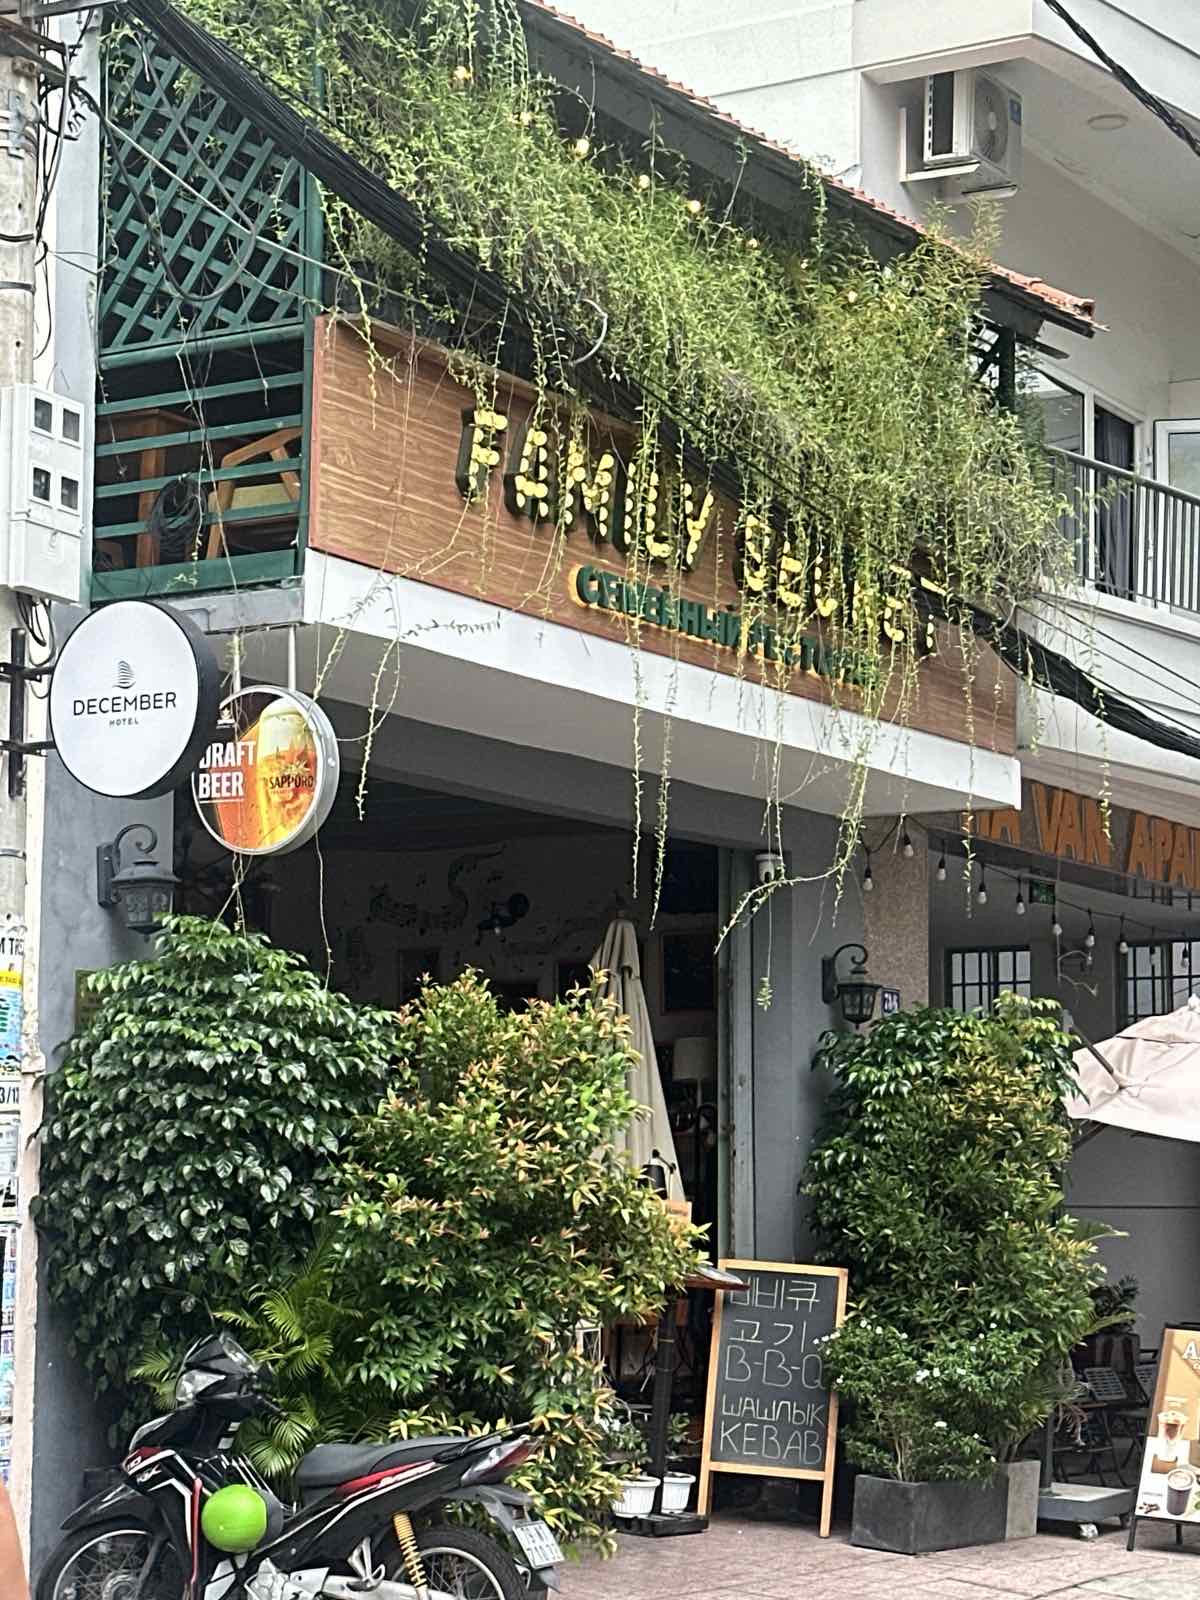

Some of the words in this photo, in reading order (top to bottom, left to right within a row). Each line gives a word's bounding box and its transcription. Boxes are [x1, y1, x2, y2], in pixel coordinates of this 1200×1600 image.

[458, 408, 714, 567] FAMILY
[73, 691, 177, 716] DECEMBER
[109, 717, 139, 727] HOTEL
[199, 771, 244, 799] BEER
[269, 774, 314, 790] SAPPORO
[728, 1318, 807, 1353] 고기
[725, 1345, 825, 1389] B-B-Q
[719, 1420, 823, 1465] KEBAB
